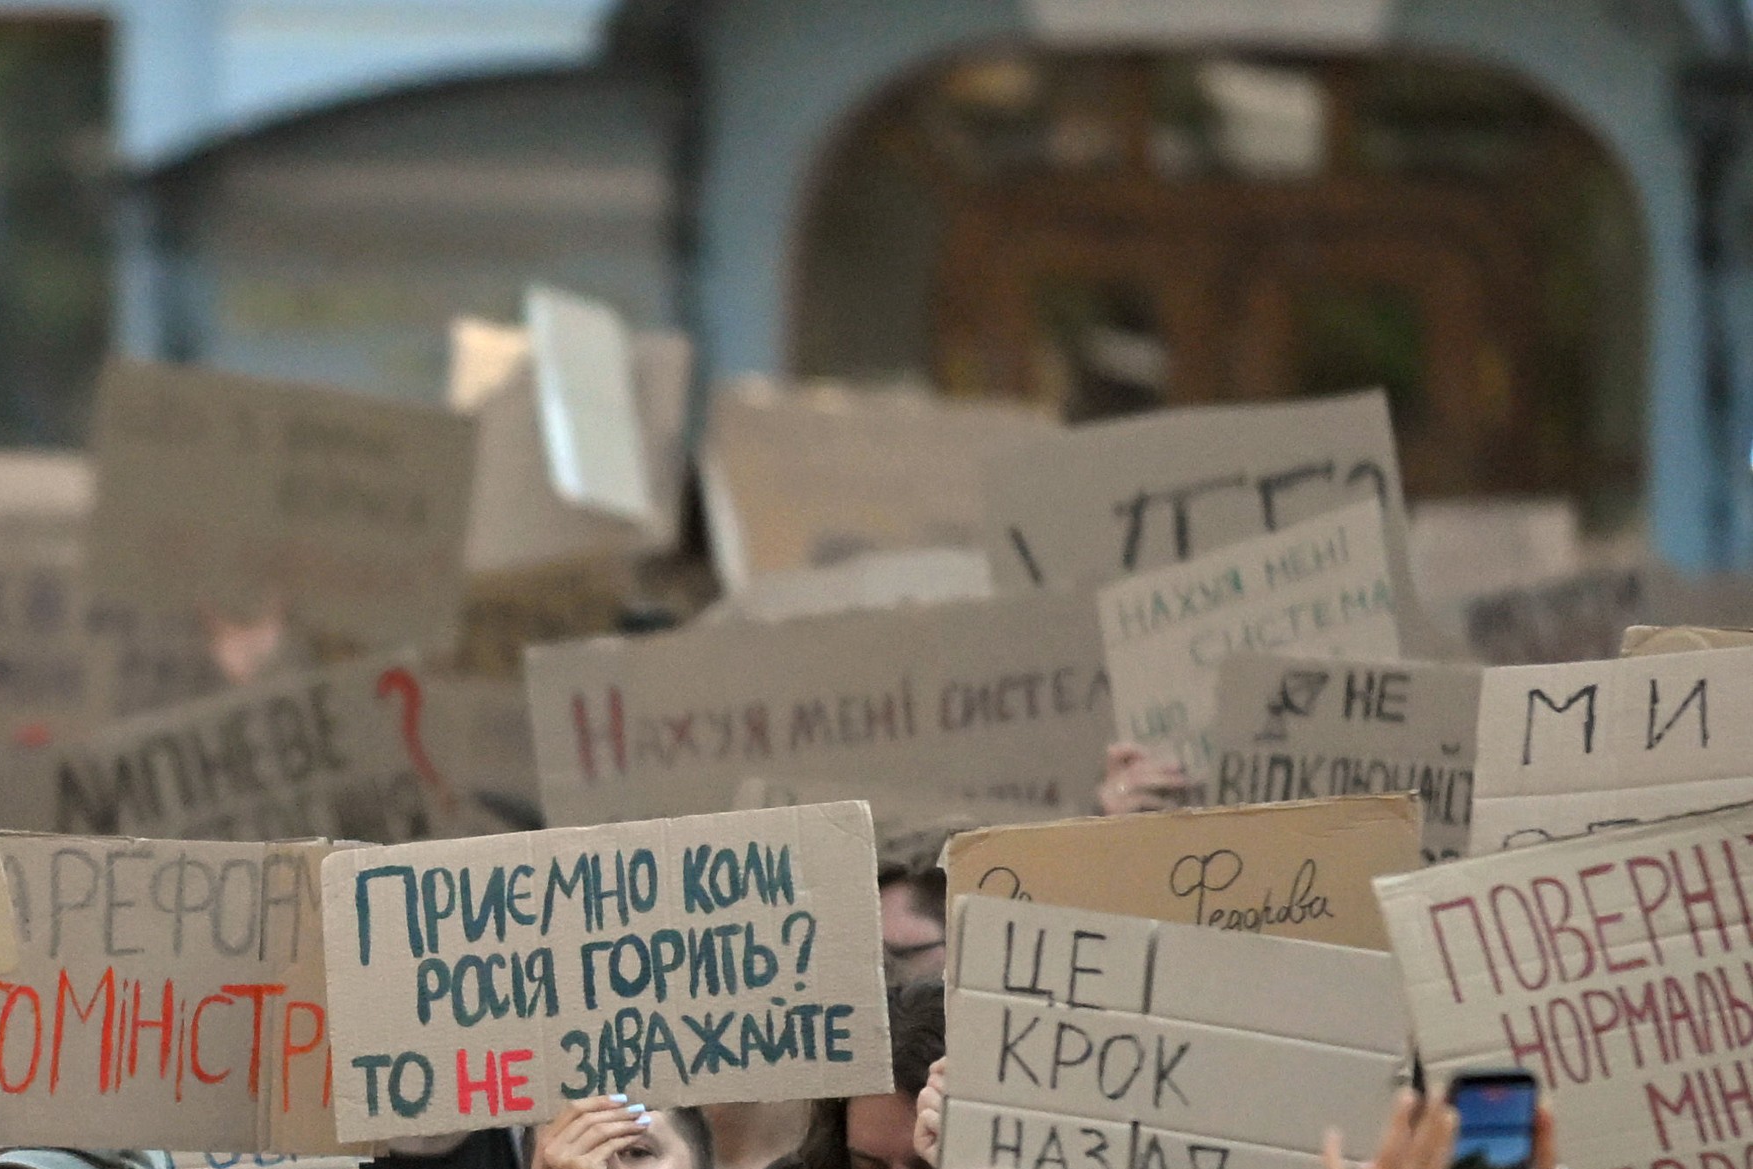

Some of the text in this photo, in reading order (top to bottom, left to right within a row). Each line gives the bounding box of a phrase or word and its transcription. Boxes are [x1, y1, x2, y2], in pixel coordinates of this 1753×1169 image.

[1342, 671, 1411, 723] НЕ
[1521, 677, 1710, 766] МИ
[355, 841, 795, 966] ПРИЄМНО КОЛИ
[1429, 832, 1753, 1003] ПОВЕРНІ
[417, 910, 816, 1027] РОСІЯ ГОРИТЬ?
[1003, 921, 1107, 1011] ЦЕ
[1500, 960, 1753, 1091] НОРМАЛЬ
[49, 966, 333, 1113] МІНІСТР
[352, 996, 855, 1118] ТО НЕ ЗАВАЖАЙТЕ
[997, 1009, 1192, 1109] КРОК
